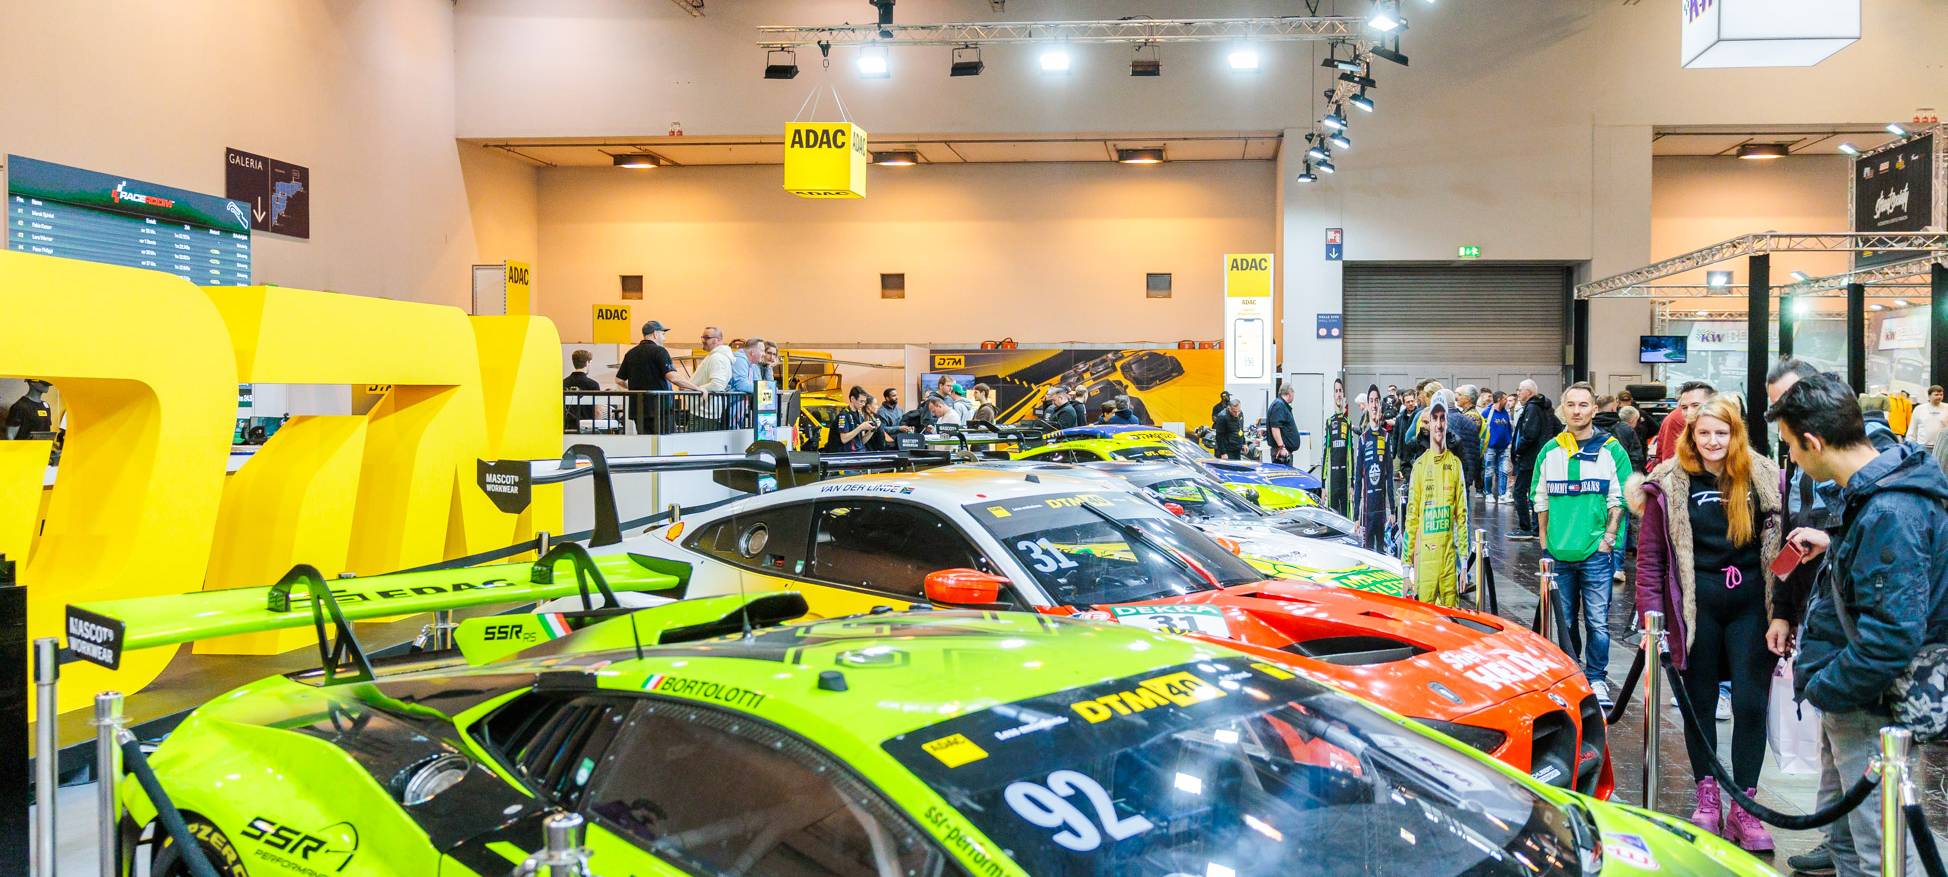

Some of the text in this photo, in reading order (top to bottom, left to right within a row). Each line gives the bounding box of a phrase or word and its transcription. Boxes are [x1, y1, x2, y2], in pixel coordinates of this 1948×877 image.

[790, 129, 846, 149] ADAC
[229, 153, 263, 171] GALERIA
[1230, 257, 1268, 271] ADAC
[508, 266, 529, 286] ADAC
[597, 308, 628, 320] ADAC
[937, 357, 962, 366] DTM
[486, 484, 519, 494] WORKWEAR
[821, 485, 842, 493] VAN
[842, 484, 865, 492] DER
[1547, 480, 1600, 494] TOMMY JEANS
[1424, 507, 1450, 520] MANN
[1425, 518, 1450, 531] FILTER
[1016, 537, 1079, 573] 31
[1117, 605, 1218, 616] DEKRA
[484, 624, 523, 641] SSR
[1148, 615, 1207, 635] 31
[69, 636, 114, 664] WORKWEAR
[661, 677, 766, 709] BORTOLOTTI
[1070, 686, 1170, 724] DTM
[1004, 769, 1155, 852] 92
[240, 816, 327, 860] SSR
